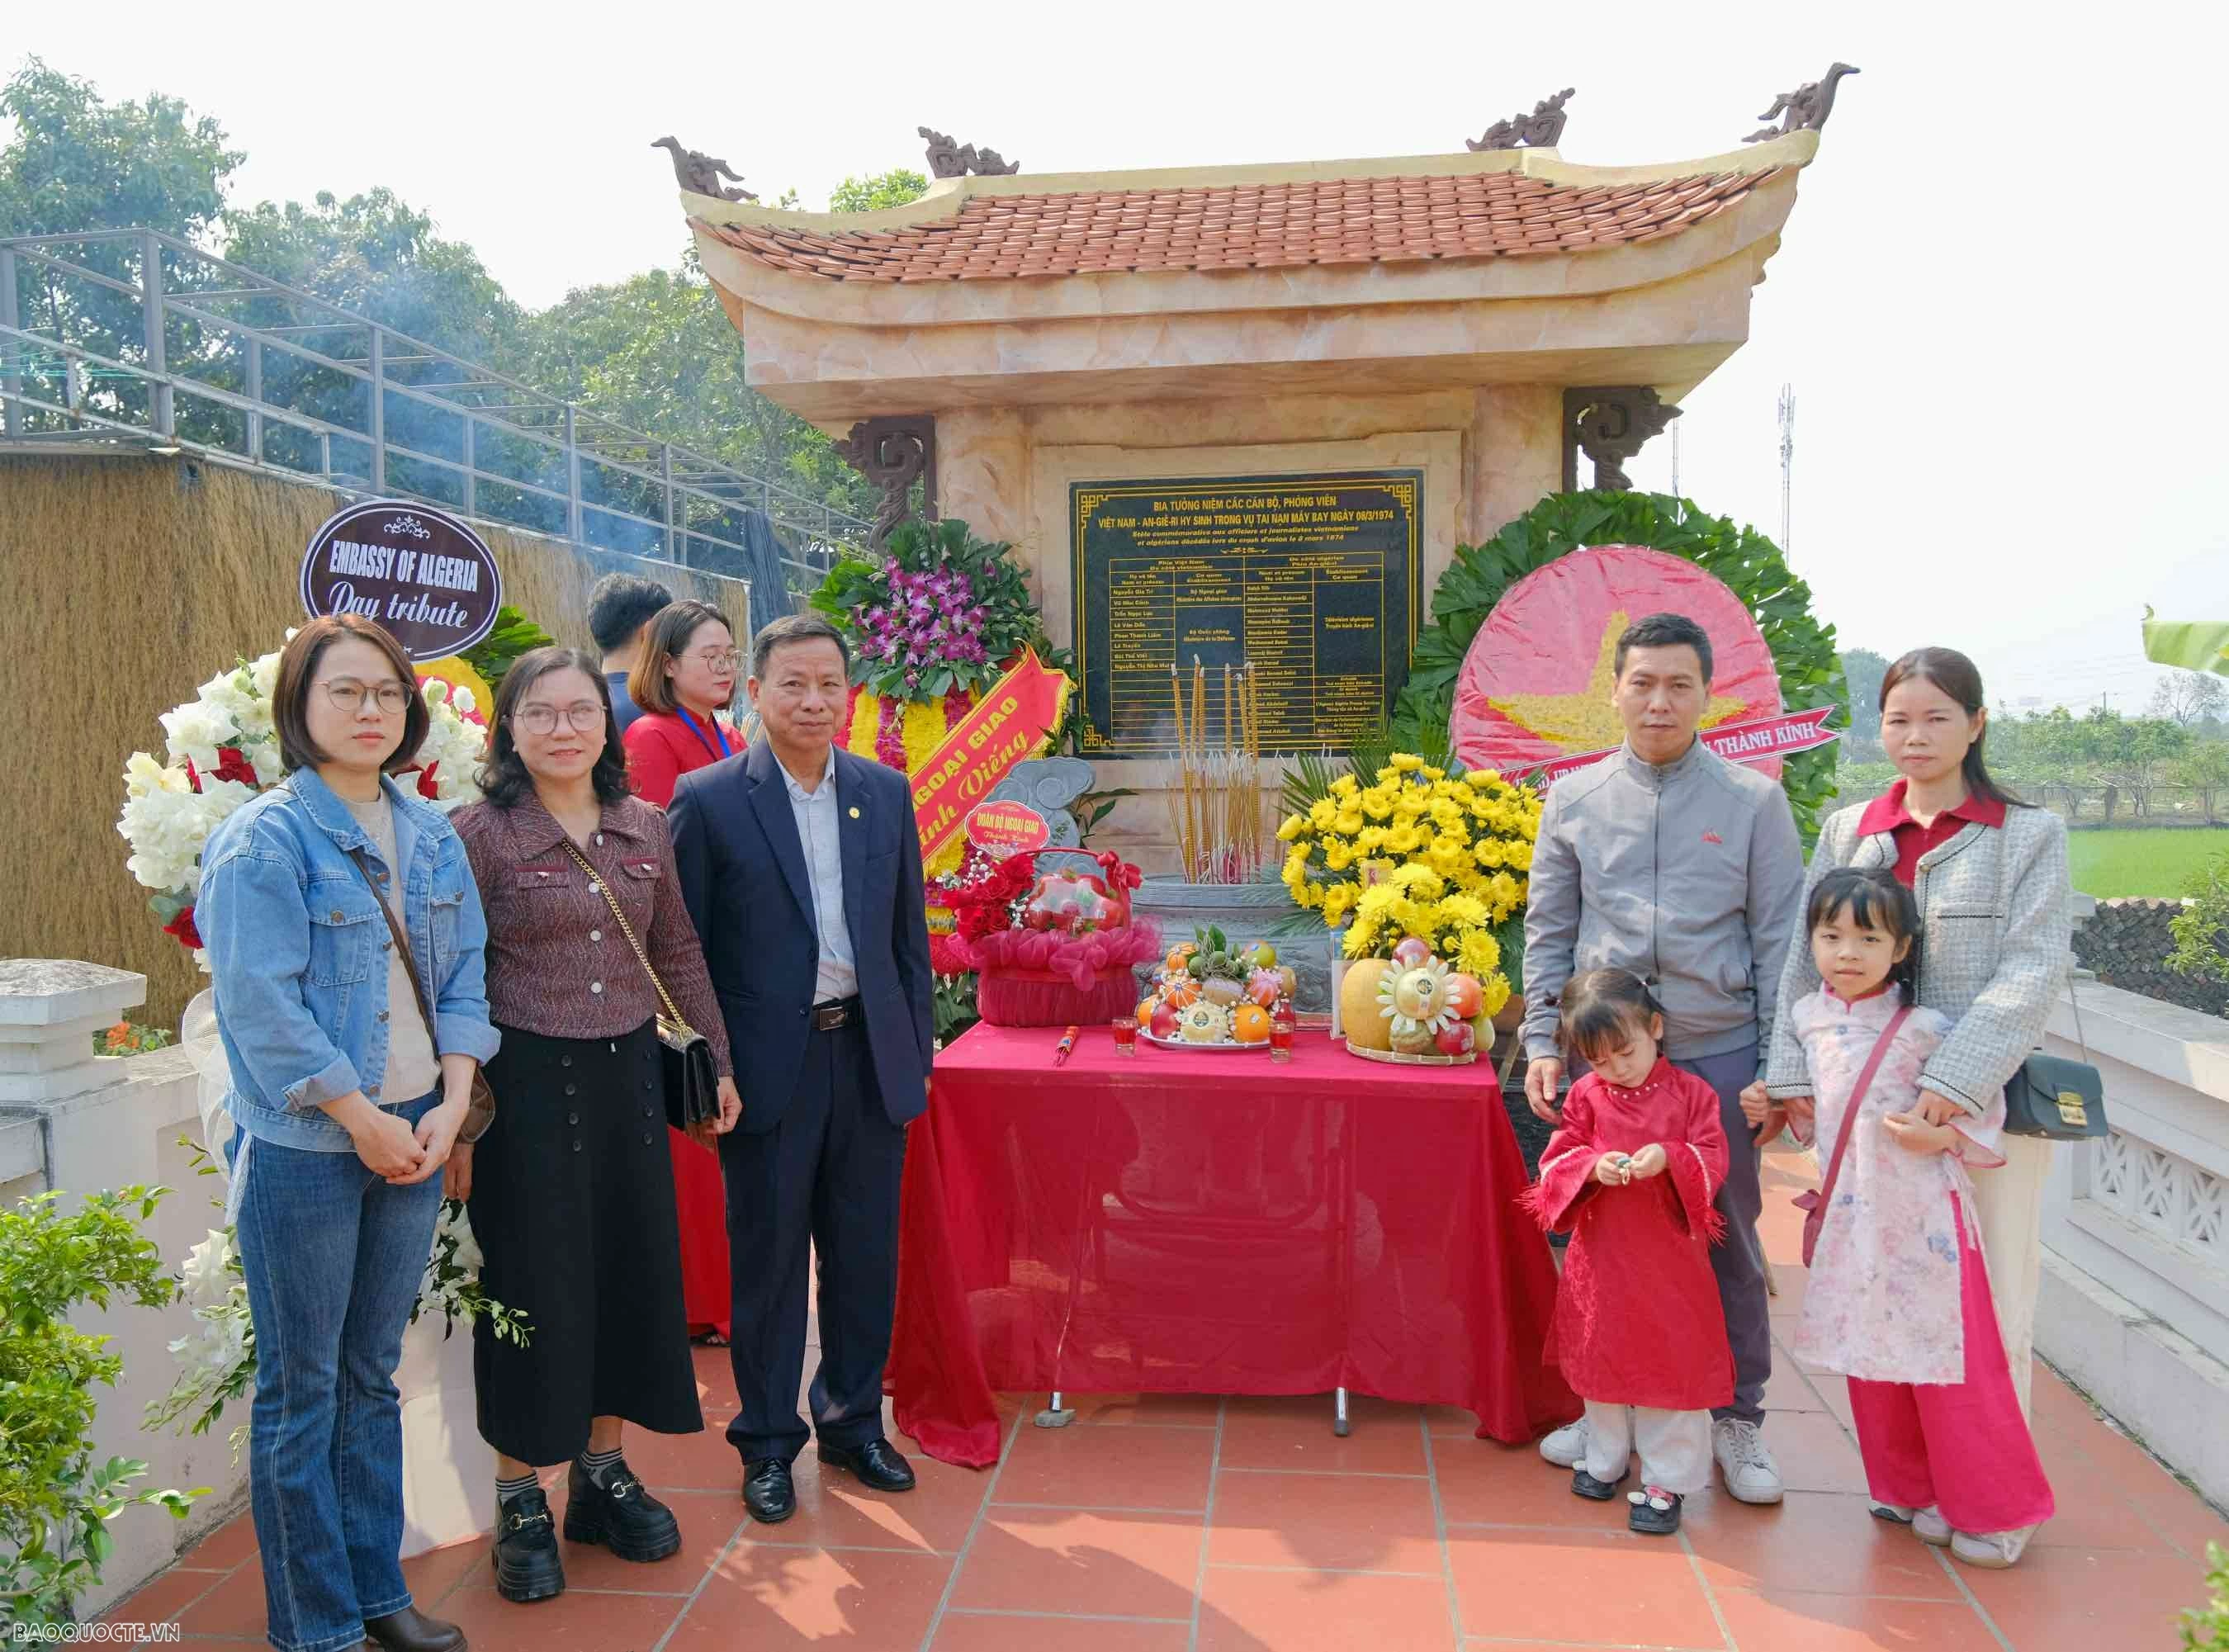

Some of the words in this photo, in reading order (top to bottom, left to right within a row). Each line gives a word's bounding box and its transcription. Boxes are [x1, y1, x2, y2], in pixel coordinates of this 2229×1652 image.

[1098, 516, 1114, 531] VIỆT
[1117, 518, 1136, 528] NAM
[1181, 516, 1192, 526] HY
[1194, 516, 1212, 525] SINH
[1214, 515, 1242, 524] TRONG
[1244, 514, 1255, 528] VỤ
[1257, 513, 1269, 523] TAI
[1271, 513, 1290, 526] NẠN
[1291, 509, 1309, 523] MÁY
[1312, 511, 1328, 523] BAY
[1331, 509, 1354, 522] NGÀY
[1153, 501, 1168, 512] BIA
[1202, 497, 1223, 512] NIỆM
[1226, 496, 1243, 509] CÁC
[330, 540, 396, 580] EMBASSY
[397, 550, 416, 583] OF
[416, 553, 478, 592] ALGERIA
[329, 581, 382, 621] Pay
[386, 593, 469, 628] tribute
[913, 750, 969, 812] GOẠI
[968, 697, 1018, 749] GIAO
[1715, 730, 1773, 755] THÀNH
[1776, 722, 1816, 742] KÍNH
[919, 803, 958, 846] ính
[1024, 820, 1040, 835] GIAO
